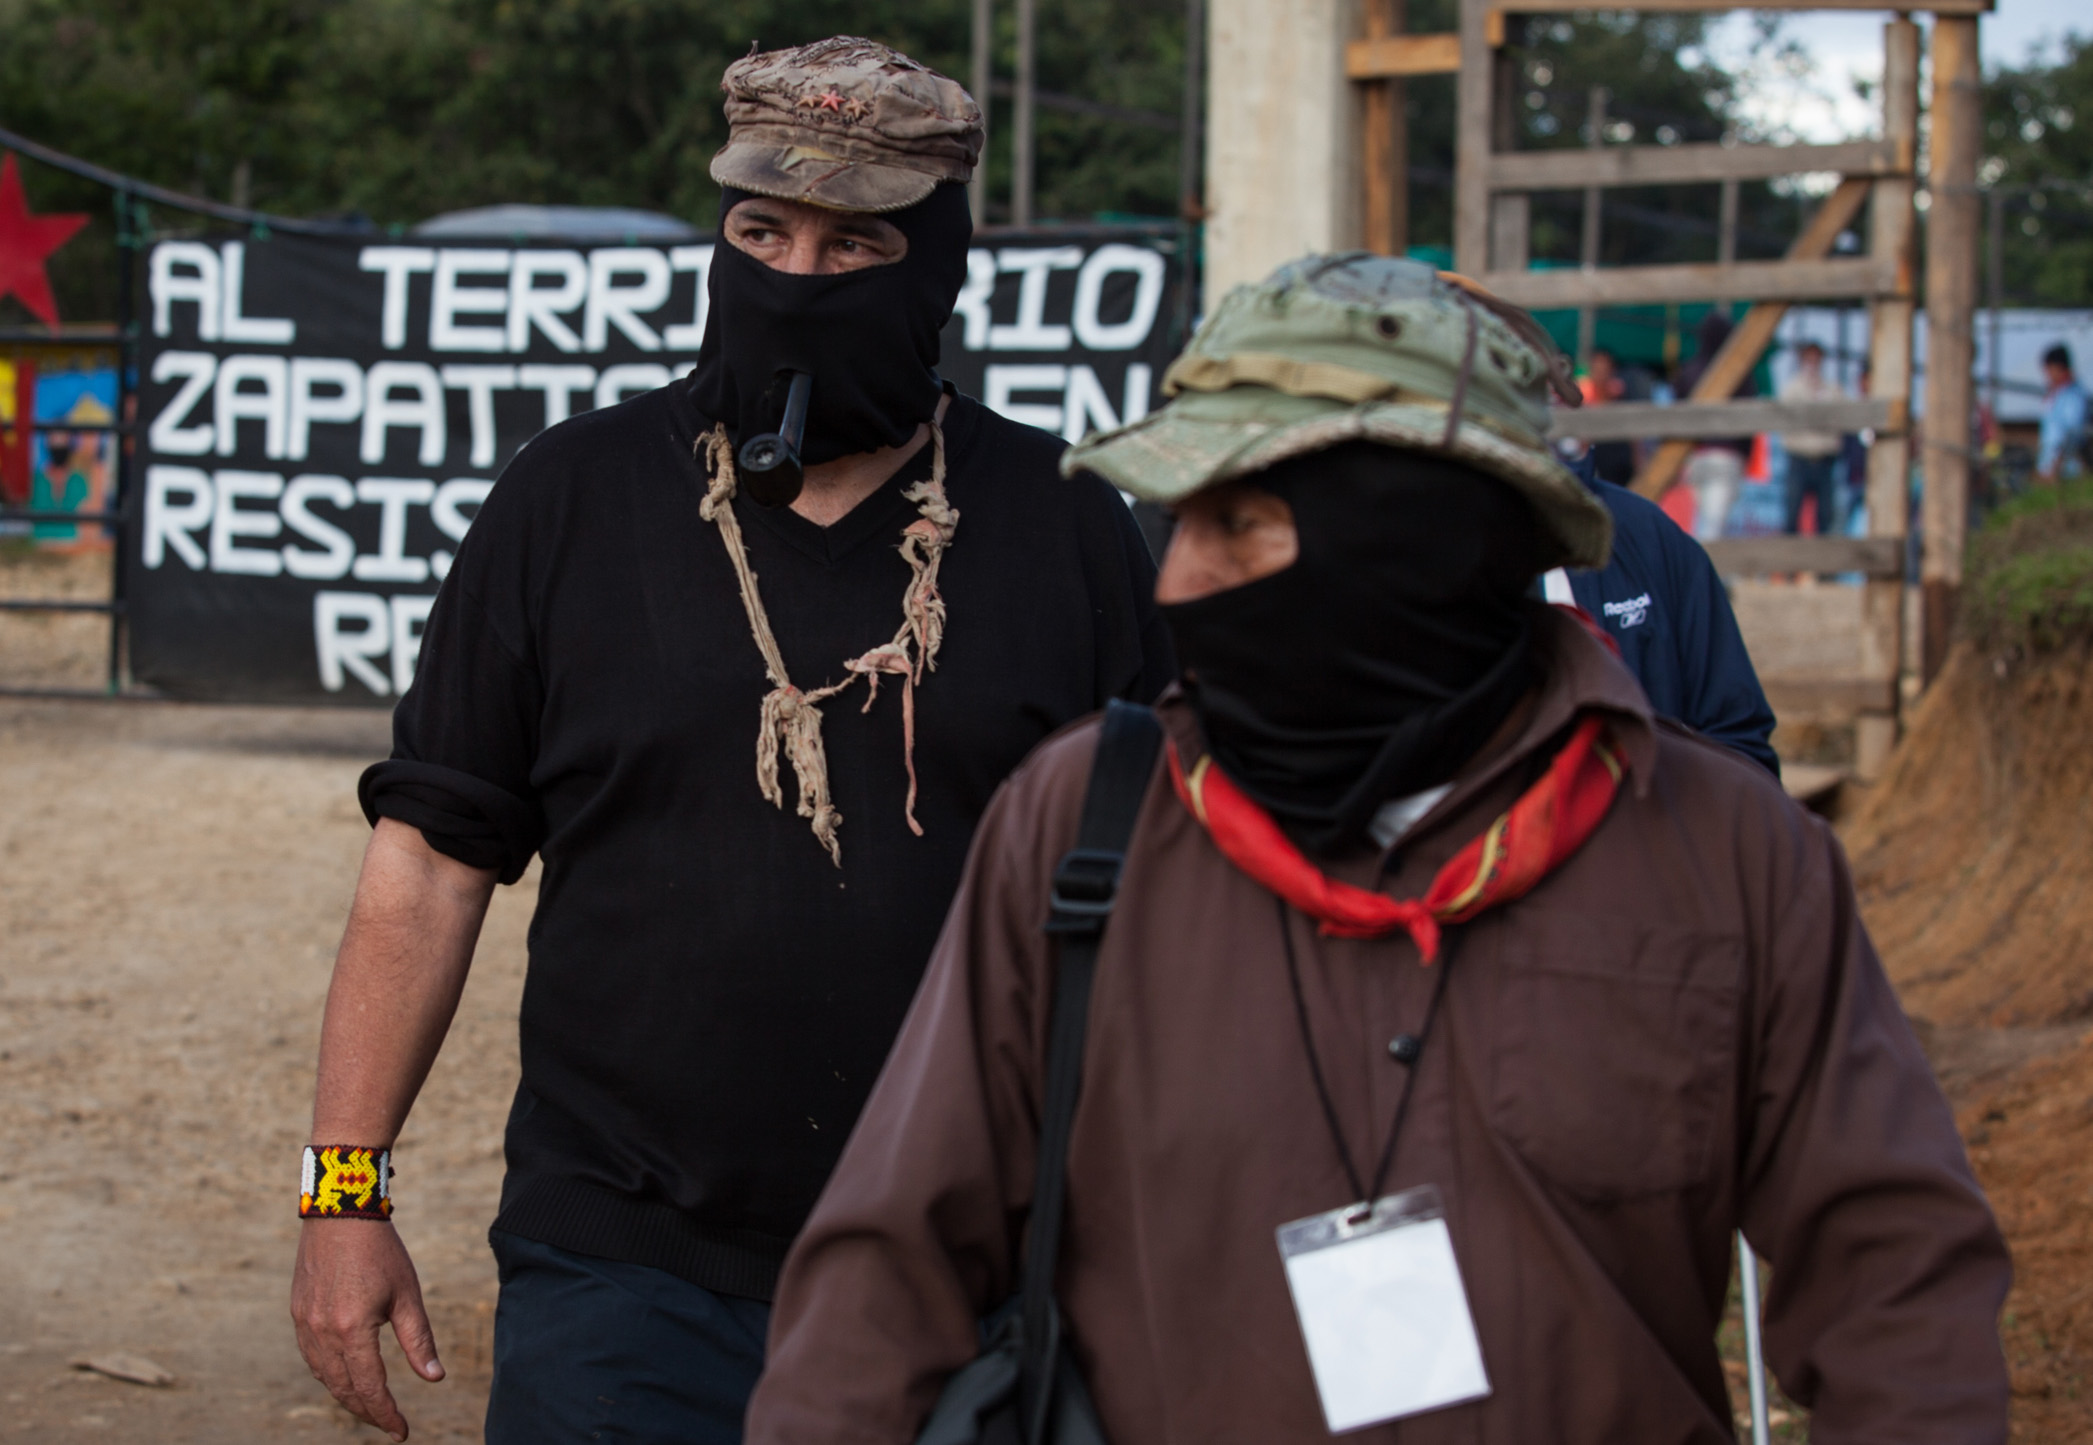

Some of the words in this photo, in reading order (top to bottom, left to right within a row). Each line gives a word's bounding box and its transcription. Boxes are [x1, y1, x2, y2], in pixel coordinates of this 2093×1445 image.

[149, 240, 296, 345] AL
[358, 243, 1167, 352] TERRIRIO
[983, 362, 1152, 448] EN
[142, 463, 497, 583] RESIS
